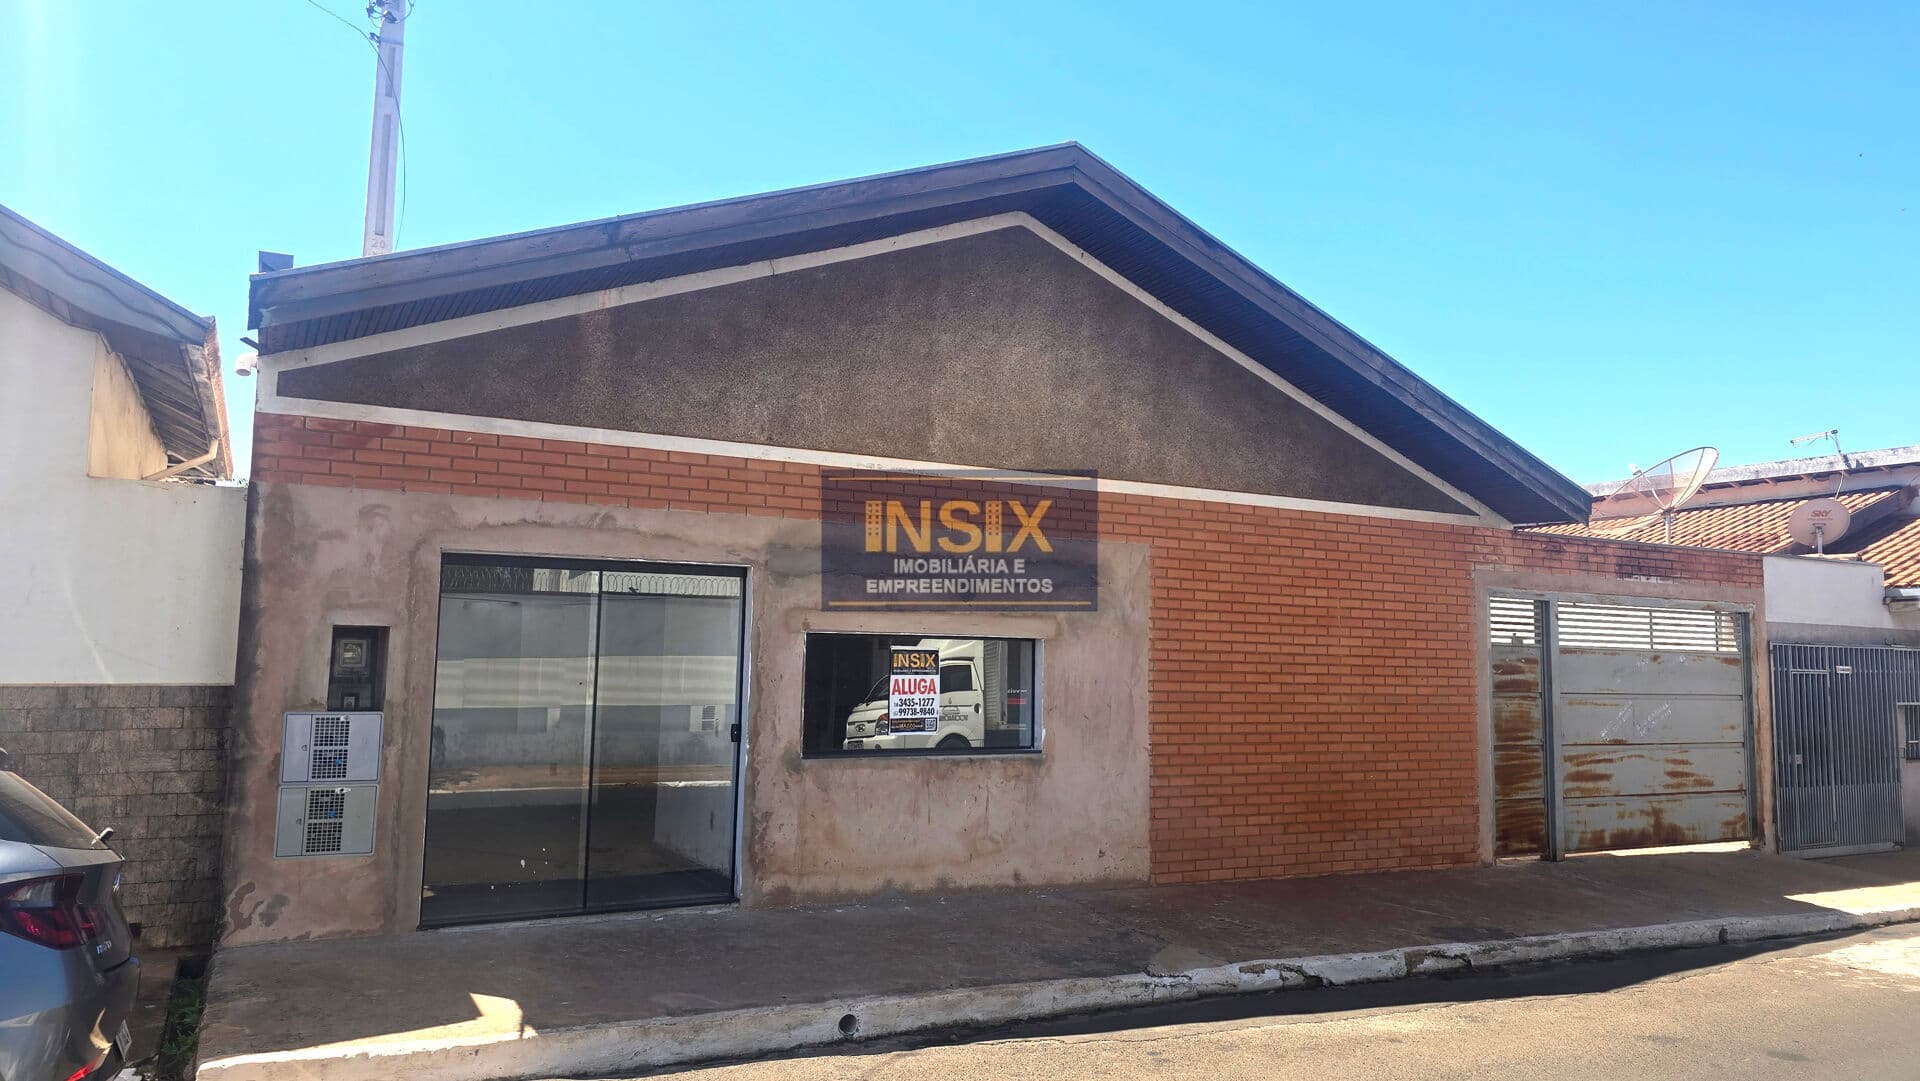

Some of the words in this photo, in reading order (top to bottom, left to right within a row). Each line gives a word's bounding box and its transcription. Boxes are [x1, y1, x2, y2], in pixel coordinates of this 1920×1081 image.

[1811, 510, 1832, 518] SKY
[893, 653, 936, 668] INSIX
[892, 678, 937, 695] ALUGA
[898, 698, 935, 707] 3435-1277
[898, 707, 935, 717] 99738-9840
